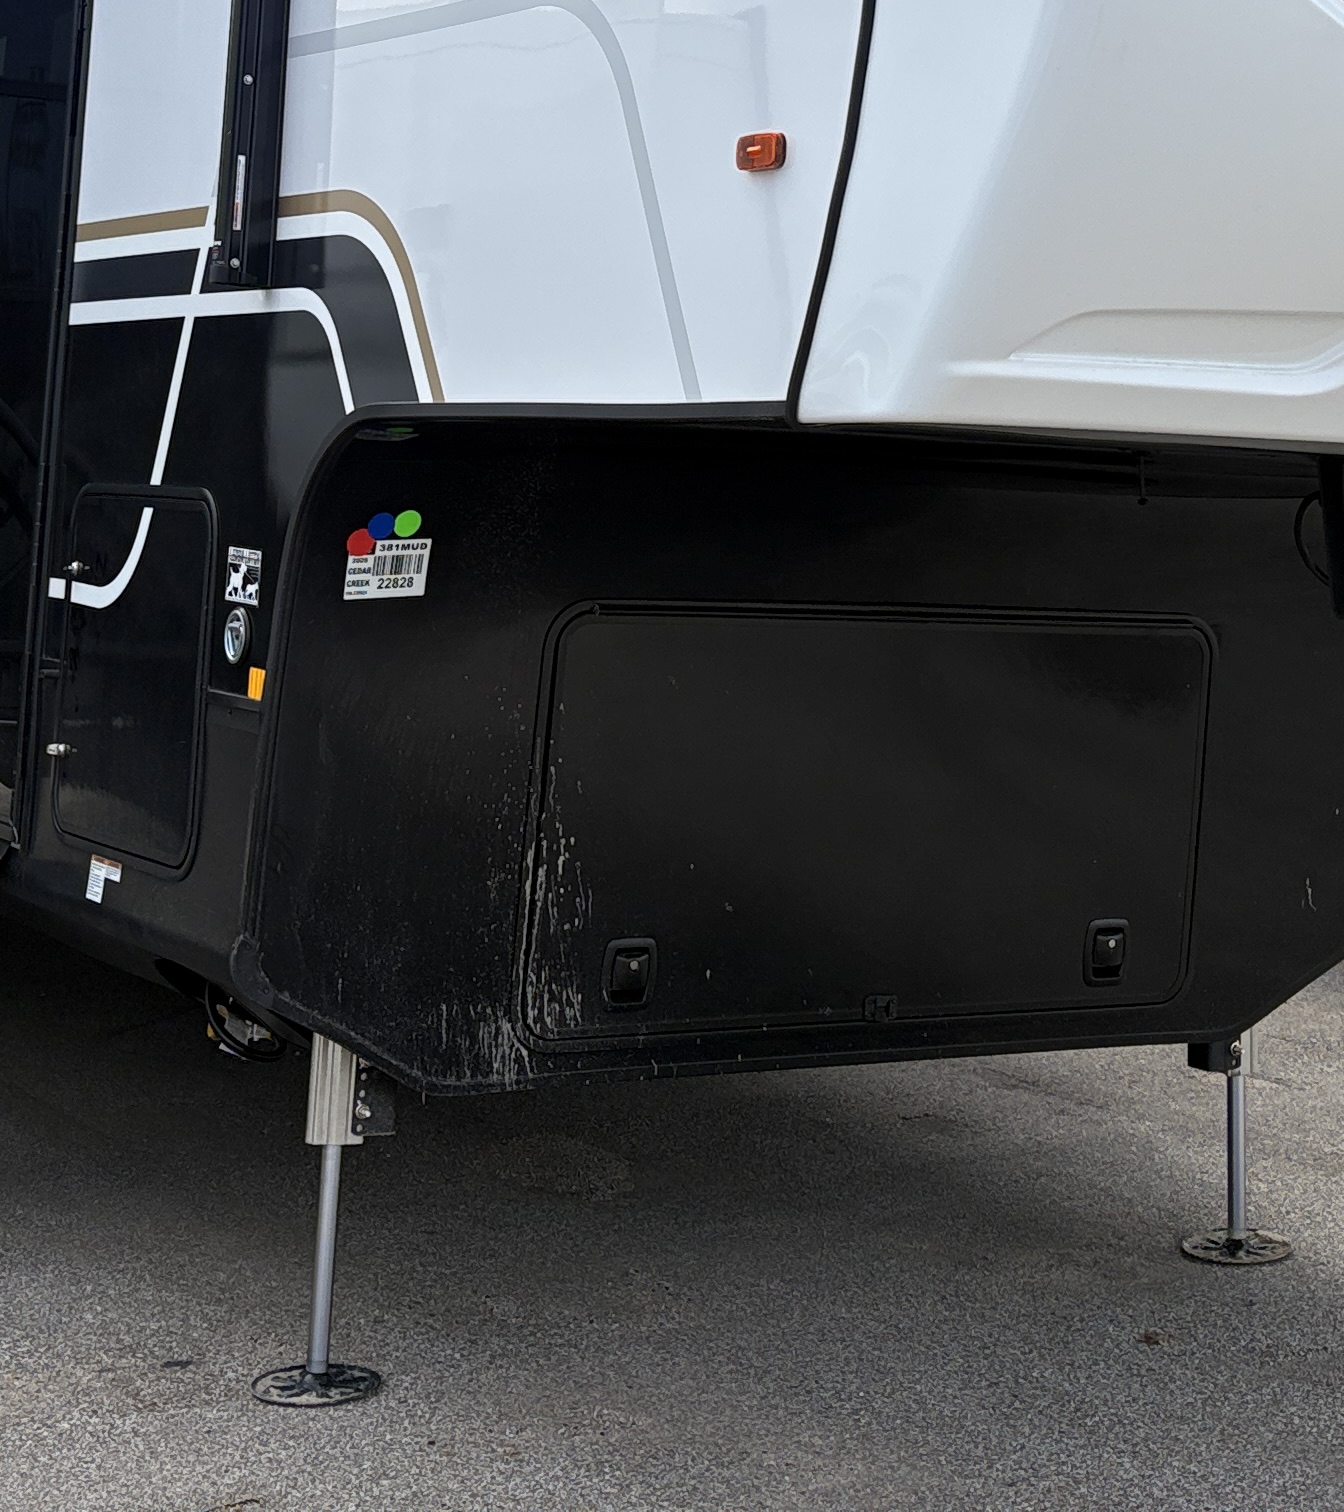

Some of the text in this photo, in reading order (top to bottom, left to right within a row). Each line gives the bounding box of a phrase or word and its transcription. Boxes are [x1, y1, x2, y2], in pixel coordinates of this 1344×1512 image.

[379, 543, 428, 552] 381MUD
[348, 567, 372, 575] CEDAR
[346, 579, 371, 588] CREEK
[376, 577, 414, 590] 22828
